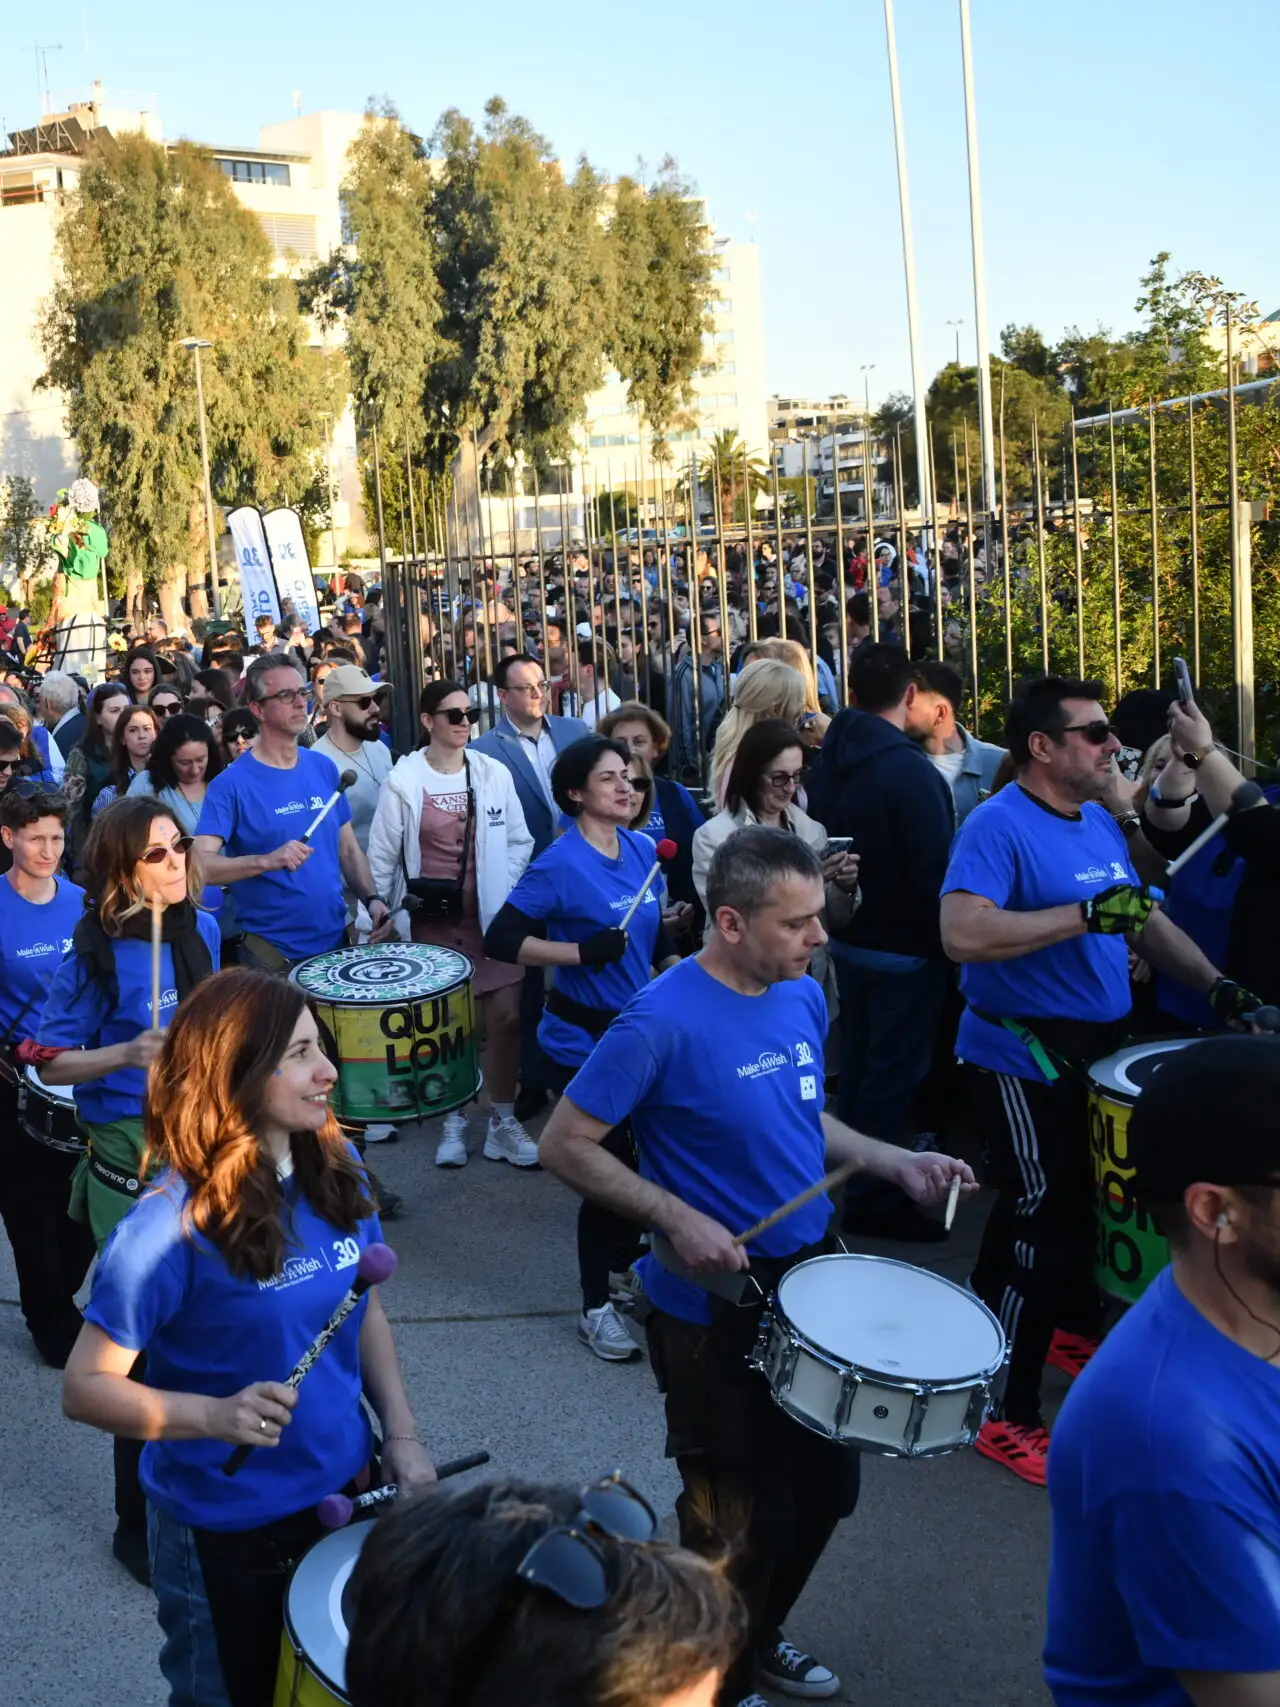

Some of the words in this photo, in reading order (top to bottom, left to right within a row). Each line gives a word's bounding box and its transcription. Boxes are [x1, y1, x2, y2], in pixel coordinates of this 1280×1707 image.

[310, 796, 324, 809] 30
[431, 794, 467, 805] KANS
[380, 997, 449, 1039] QUI
[386, 1026, 465, 1075] LOM
[795, 1042, 812, 1064] 30
[333, 1237, 359, 1268] 30
